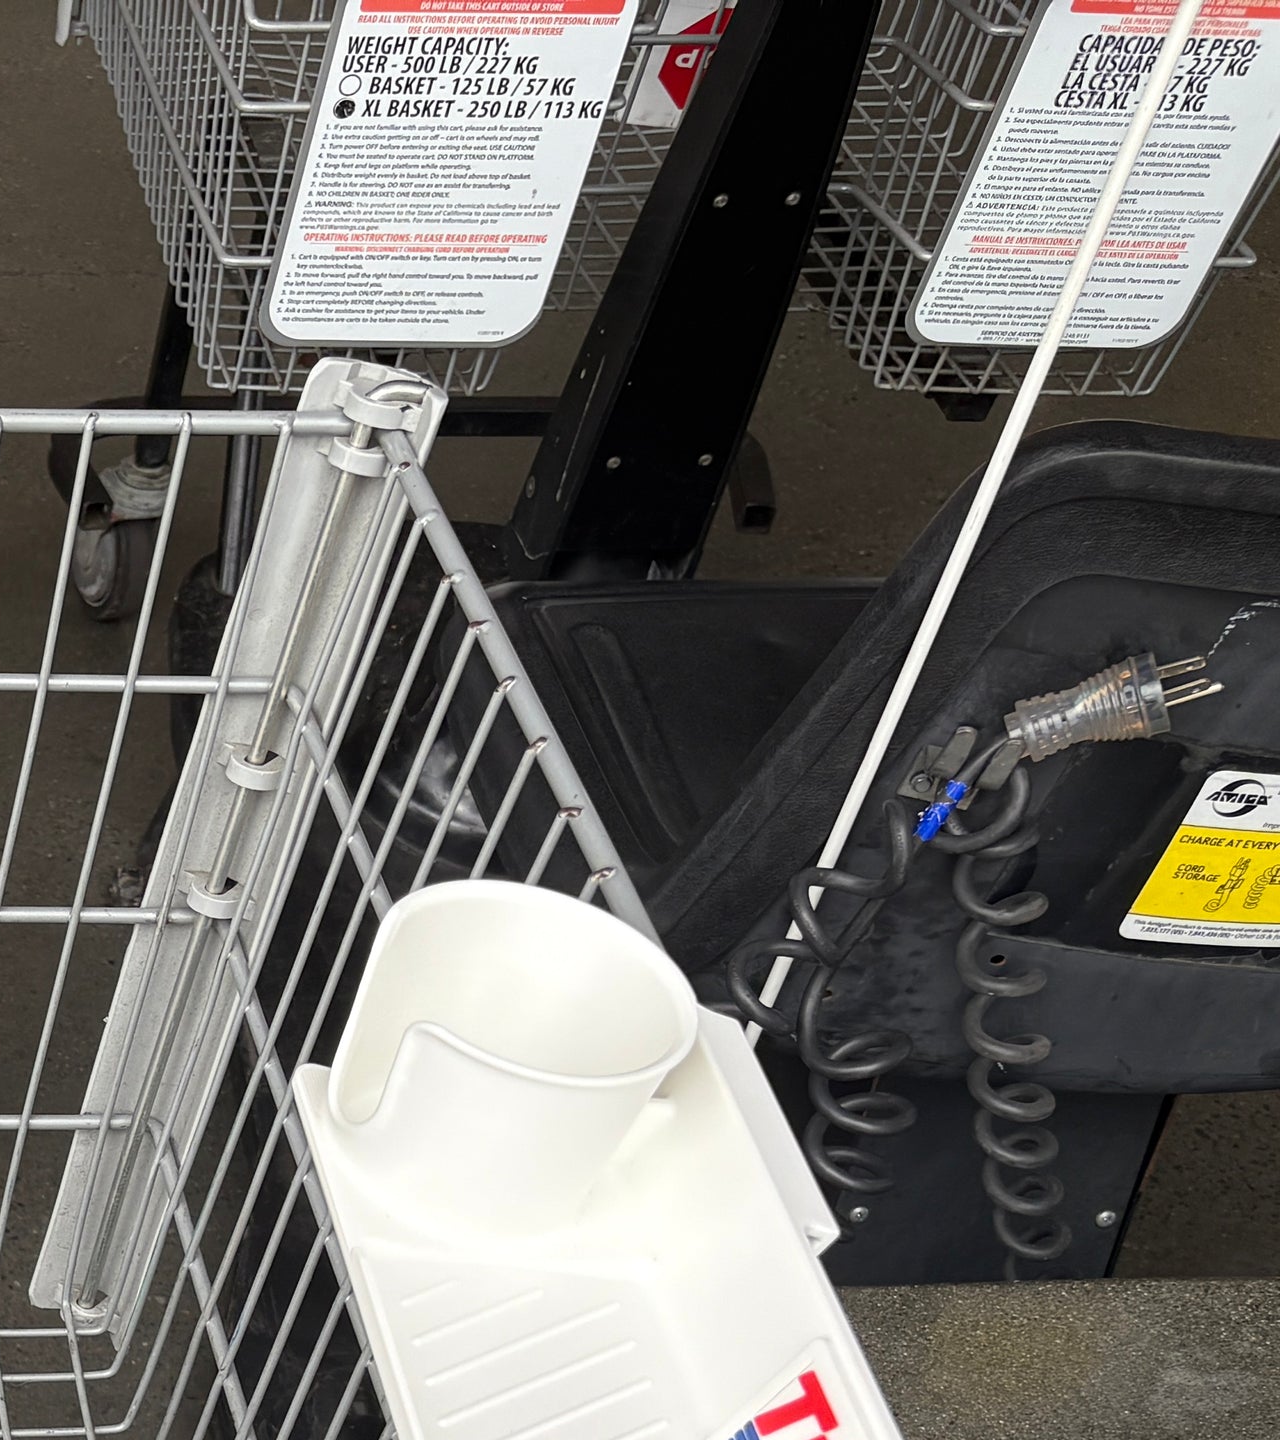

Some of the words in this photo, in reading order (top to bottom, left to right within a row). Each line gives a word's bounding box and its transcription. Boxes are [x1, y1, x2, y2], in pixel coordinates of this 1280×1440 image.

[420, 2, 431, 10] DO
[432, 2, 446, 10] NOT
[447, 2, 464, 10] TAKE
[465, 2, 481, 10] THIS
[482, 2, 500, 10] CART
[501, 2, 531, 11] OUTSIDE
[531, 3, 540, 11] OF
[542, 3, 564, 11] STORE
[358, 15, 378, 23] READ
[380, 15, 392, 23] ALL
[393, 15, 446, 24] INSTRUCTIONS
[448, 16, 475, 24] BEFORE
[477, 16, 519, 25] OPERATING
[520, 16, 529, 24] TO
[530, 16, 552, 25] AVOID
[554, 17, 591, 25] PERSONAL
[593, 17, 620, 25] INJURY
[408, 26, 422, 34] USE
[423, 26, 455, 34] CAUTION
[456, 26, 478, 34] WHEN
[480, 27, 520, 35] OPERATING
[522, 27, 530, 35] IN
[532, 27, 564, 36] REVERSE
[348, 36, 417, 55] WEIGHT
[421, 37, 510, 56] CAPACITY:
[1182, 38, 1208, 56] DE
[1208, 39, 1263, 59] PESO:
[342, 55, 388, 73] USER
[401, 56, 436, 74] 500
[439, 56, 461, 74] LB
[476, 57, 511, 74] 227
[513, 57, 539, 75] KG
[1069, 53, 1089, 72] EL
[1187, 58, 1224, 76] 227
[1224, 58, 1253, 77] KG
[368, 77, 438, 95] BASKET
[451, 78, 482, 96] 125
[489, 78, 511, 96] LB
[525, 78, 548, 96] 57
[550, 78, 576, 96] KG
[1061, 72, 1085, 90] LA
[1088, 72, 1141, 92] CESTA
[1184, 76, 1212, 94] KG
[361, 99, 384, 118] XL
[386, 100, 455, 119] BASKET
[466, 100, 499, 119] 250
[504, 101, 527, 119] LB
[543, 101, 574, 119] 113
[578, 101, 604, 119] KG
[1054, 90, 1109, 110] CESTA
[1107, 91, 1130, 110] XL
[1180, 94, 1208, 112] KG
[304, 233, 349, 242] OPERATING
[351, 233, 413, 242] INSTRUCTIONS:
[414, 234, 444, 243] PLEASE
[445, 234, 467, 242] READ
[468, 234, 500, 244] BEFORE
[501, 235, 548, 244] OPERATING
[1205, 790, 1269, 806] AMIGA
[1179, 834, 1225, 847] CHARGE
[1225, 839, 1243, 848] AT
[1243, 840, 1280, 851] EVERY
[1172, 871, 1221, 883] STORAGE
[1177, 863, 1205, 873] CORD
